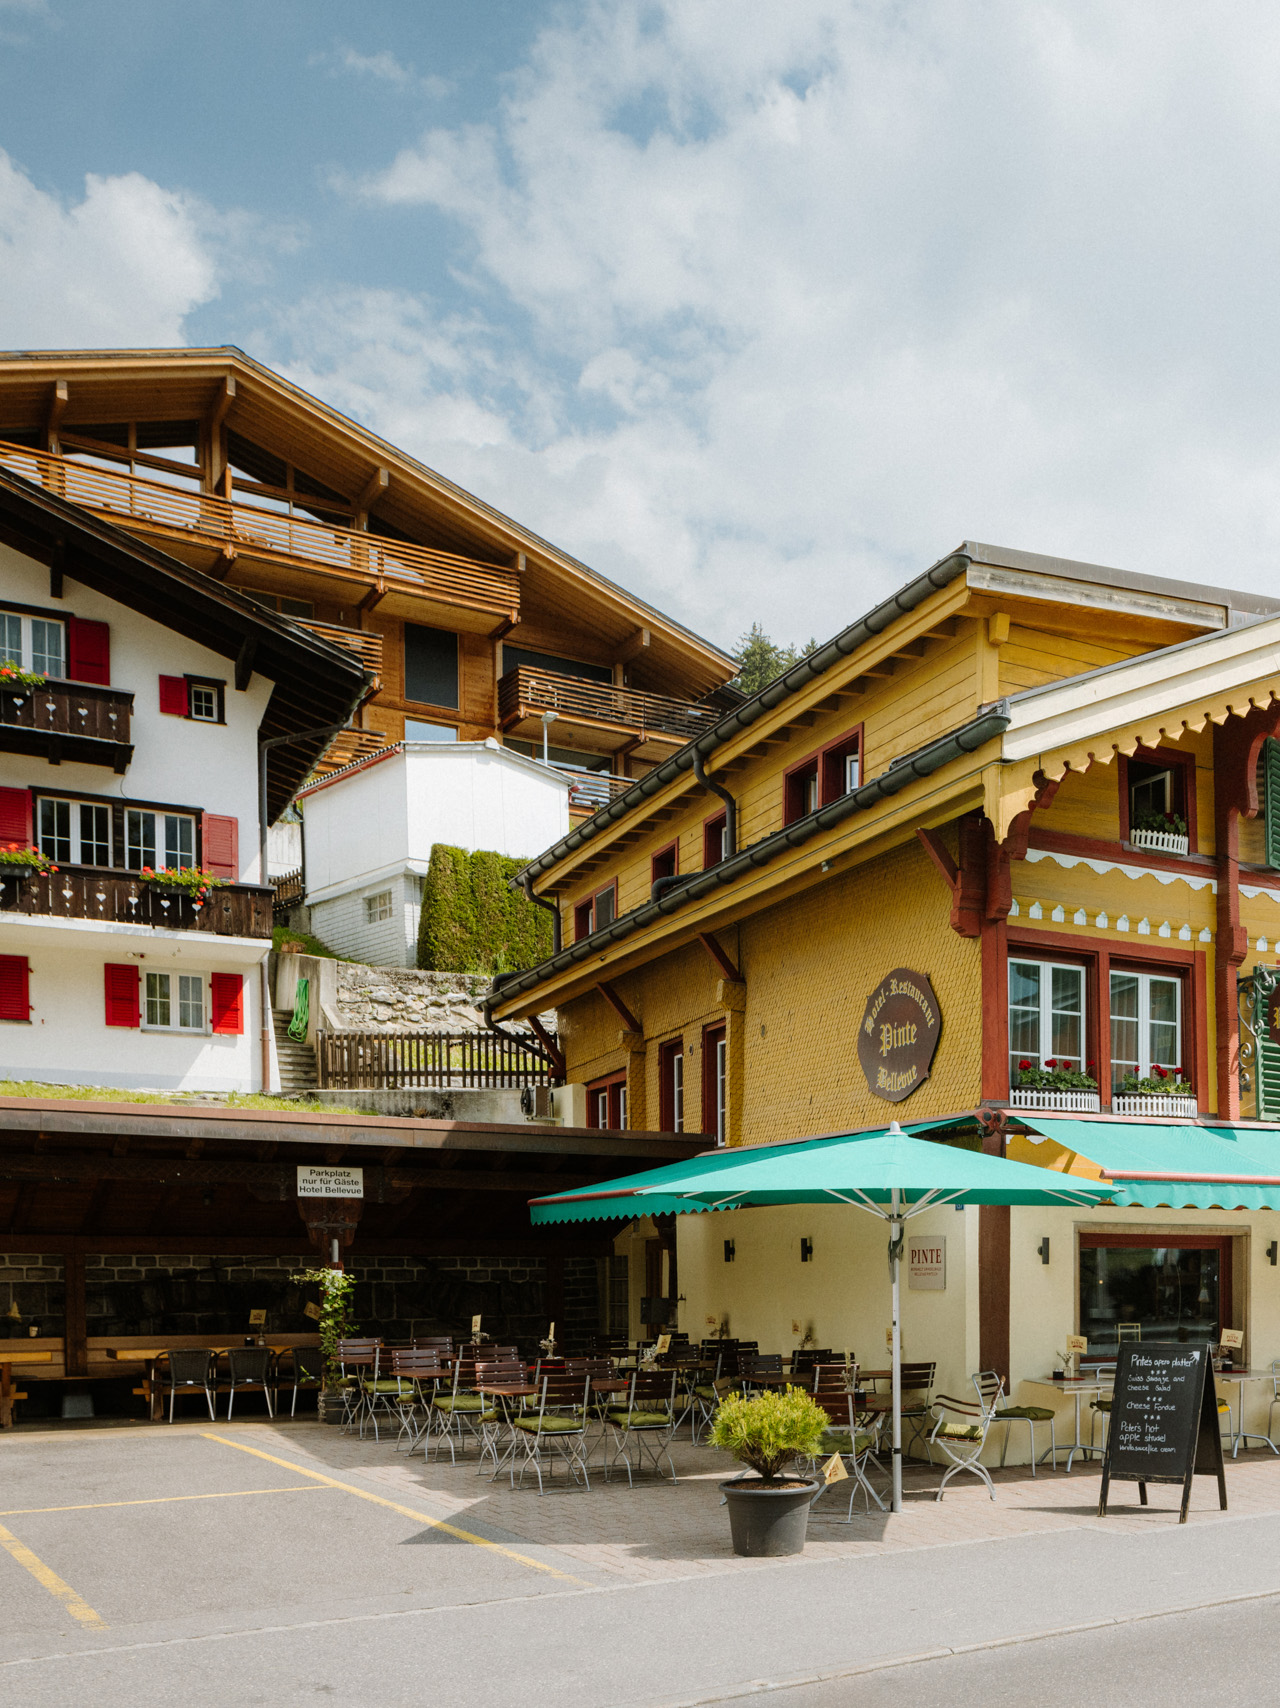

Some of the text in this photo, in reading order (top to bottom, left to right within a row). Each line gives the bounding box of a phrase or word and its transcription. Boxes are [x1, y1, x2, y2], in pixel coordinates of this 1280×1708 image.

[879, 1021, 917, 1057] Pinte
[876, 1065, 917, 1092] Bellevue
[309, 1169, 351, 1178] Parkplatz
[334, 1178, 359, 1186] Gäste
[299, 1186, 361, 1194] Hotel Bellevue
[911, 1249, 942, 1264] PINTE
[1172, 1357, 1192, 1368] platter
[1126, 1401, 1176, 1411] Cheese Fondue
[1145, 1423, 1159, 1432] hot
[1119, 1433, 1140, 1444] apple
